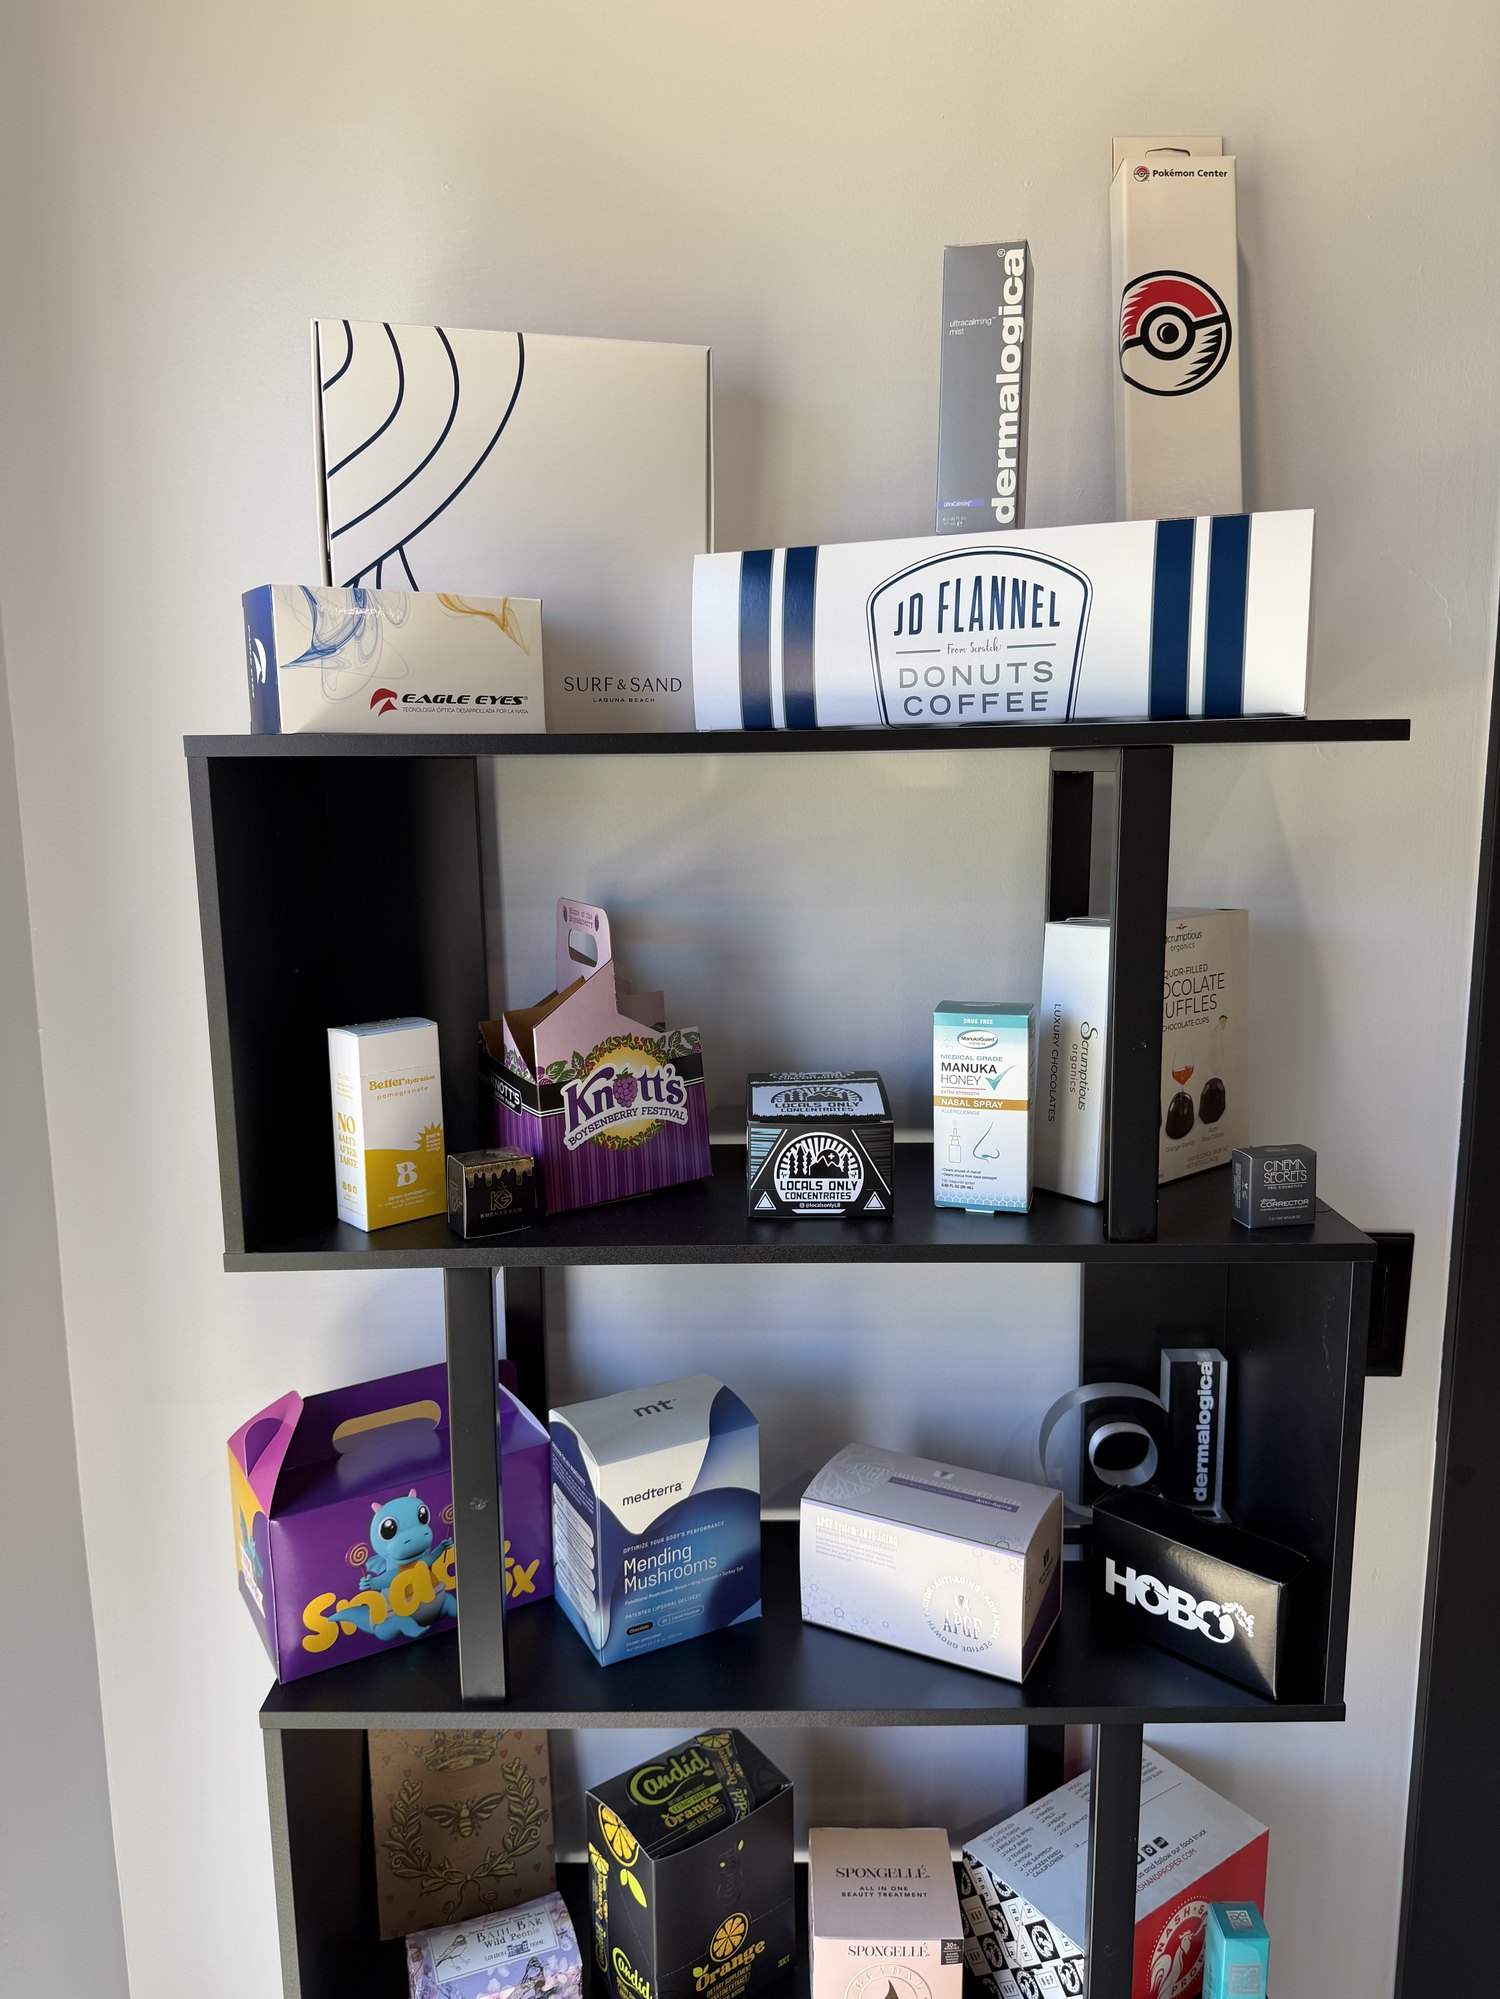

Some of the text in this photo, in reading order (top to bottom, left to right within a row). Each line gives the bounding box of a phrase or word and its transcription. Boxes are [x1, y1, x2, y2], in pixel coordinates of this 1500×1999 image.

[1152, 168, 1228, 178] Pokémon Center
[991, 248, 1025, 524] dermalogica
[894, 575, 1060, 636] JD FLANNEL
[564, 676, 683, 692] SURF & SAND
[899, 661, 1053, 688] DONUTS
[402, 693, 524, 706] EAGLE EYES
[903, 691, 1049, 717] COFFEE
[1165, 930, 1202, 944] crumptious
[1164, 963, 1208, 979] QUOR-FILLED
[1163, 973, 1225, 1000] OCOLATE
[1165, 993, 1217, 1018] UFFLES
[941, 1062, 997, 1074] MANUKA
[1048, 1003, 1062, 1122] LUXURY CHOCOLATES
[1069, 1044, 1079, 1093] organics
[1077, 1021, 1099, 1111] Scrumptious
[369, 1078, 403, 1091] Better
[940, 1074, 981, 1085] HONEY
[377, 1086, 429, 1100] pomegranate
[941, 1098, 1003, 1109] NASAL SPRAY
[337, 1111, 356, 1134] NO
[641, 1107, 686, 1120] FESTIVAL
[568, 1107, 639, 1146] BOYSENBERRY
[396, 1161, 418, 1187] B
[1263, 1159, 1306, 1172] CINEMA
[1263, 1170, 1307, 1183] SECRETS
[780, 1181, 858, 1190] LOCALS ONLY
[784, 1192, 852, 1200] CONCENTRATES
[1260, 1199, 1309, 1208] CORRECTOR
[633, 1400, 674, 1417] mt
[1193, 1361, 1214, 1502] dermalogica
[622, 1482, 683, 1507] medterra
[624, 1545, 692, 1576] Mending
[624, 1556, 717, 1594] Mushrooms
[1105, 1557, 1236, 1644] HOBO
[627, 1748, 710, 1806] Candid
[663, 1795, 719, 1828] Orange
[1144, 1862, 1156, 1874] and
[1155, 1852, 1172, 1866] follow
[1171, 1847, 1181, 1856] our
[1180, 1837, 1194, 1849] food
[1192, 1829, 1207, 1841] truck
[836, 1865, 930, 1879] SPONGELLÉ
[1135, 1848, 1198, 1894] ASHANDPROPER.COM
[516, 1917, 543, 1931] BAR
[1157, 1906, 1190, 1953] NASH
[484, 1936, 506, 1949] Wild
[848, 1942, 930, 1957] SPONGELLÉ
[695, 1940, 766, 1992] Orange
